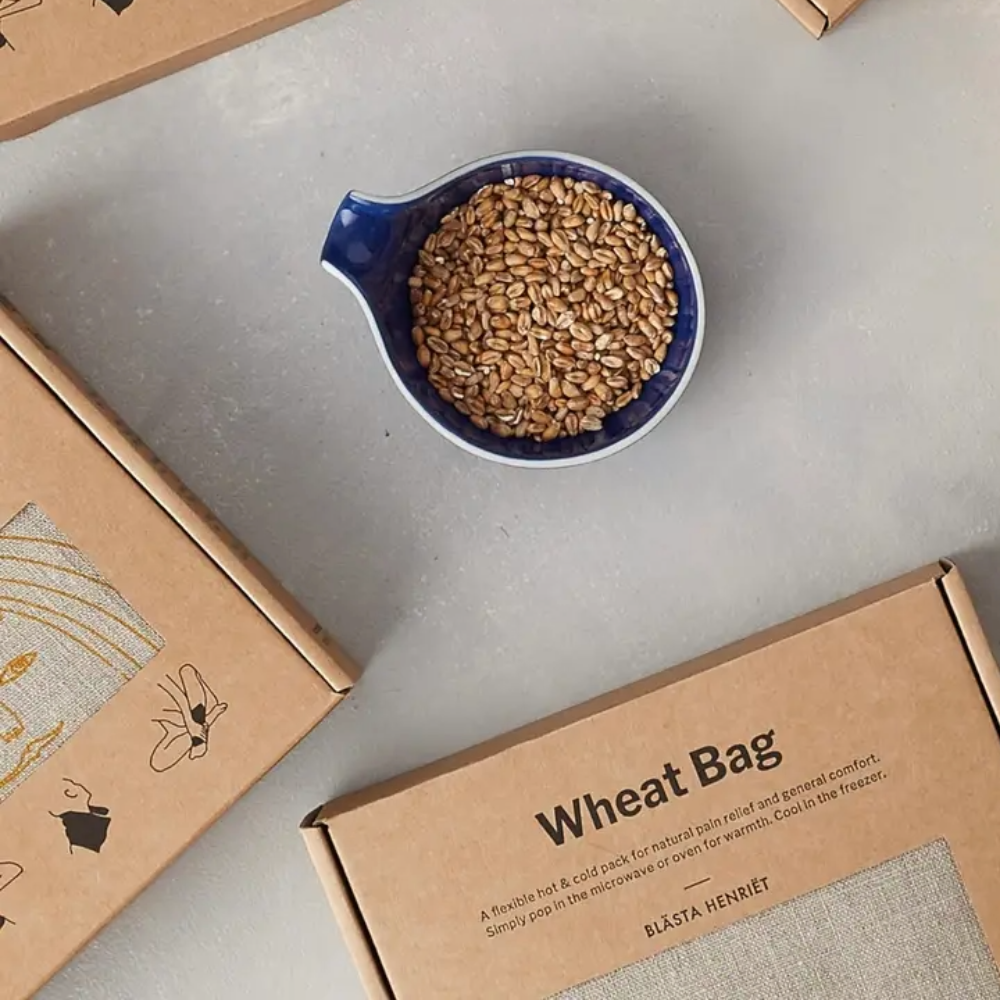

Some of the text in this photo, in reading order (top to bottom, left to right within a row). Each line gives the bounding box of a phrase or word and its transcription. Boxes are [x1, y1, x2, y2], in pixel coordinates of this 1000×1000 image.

[481, 754, 880, 922] A flexible hot & cold pack for natural pain relief and general comfort.
[486, 770, 886, 937] Simply pop in the microwave or oven for warmth. Cool in the freezer.
[535, 729, 782, 845] Wheat Bag
[644, 877, 768, 937] BLÄSTA HENRIËT
